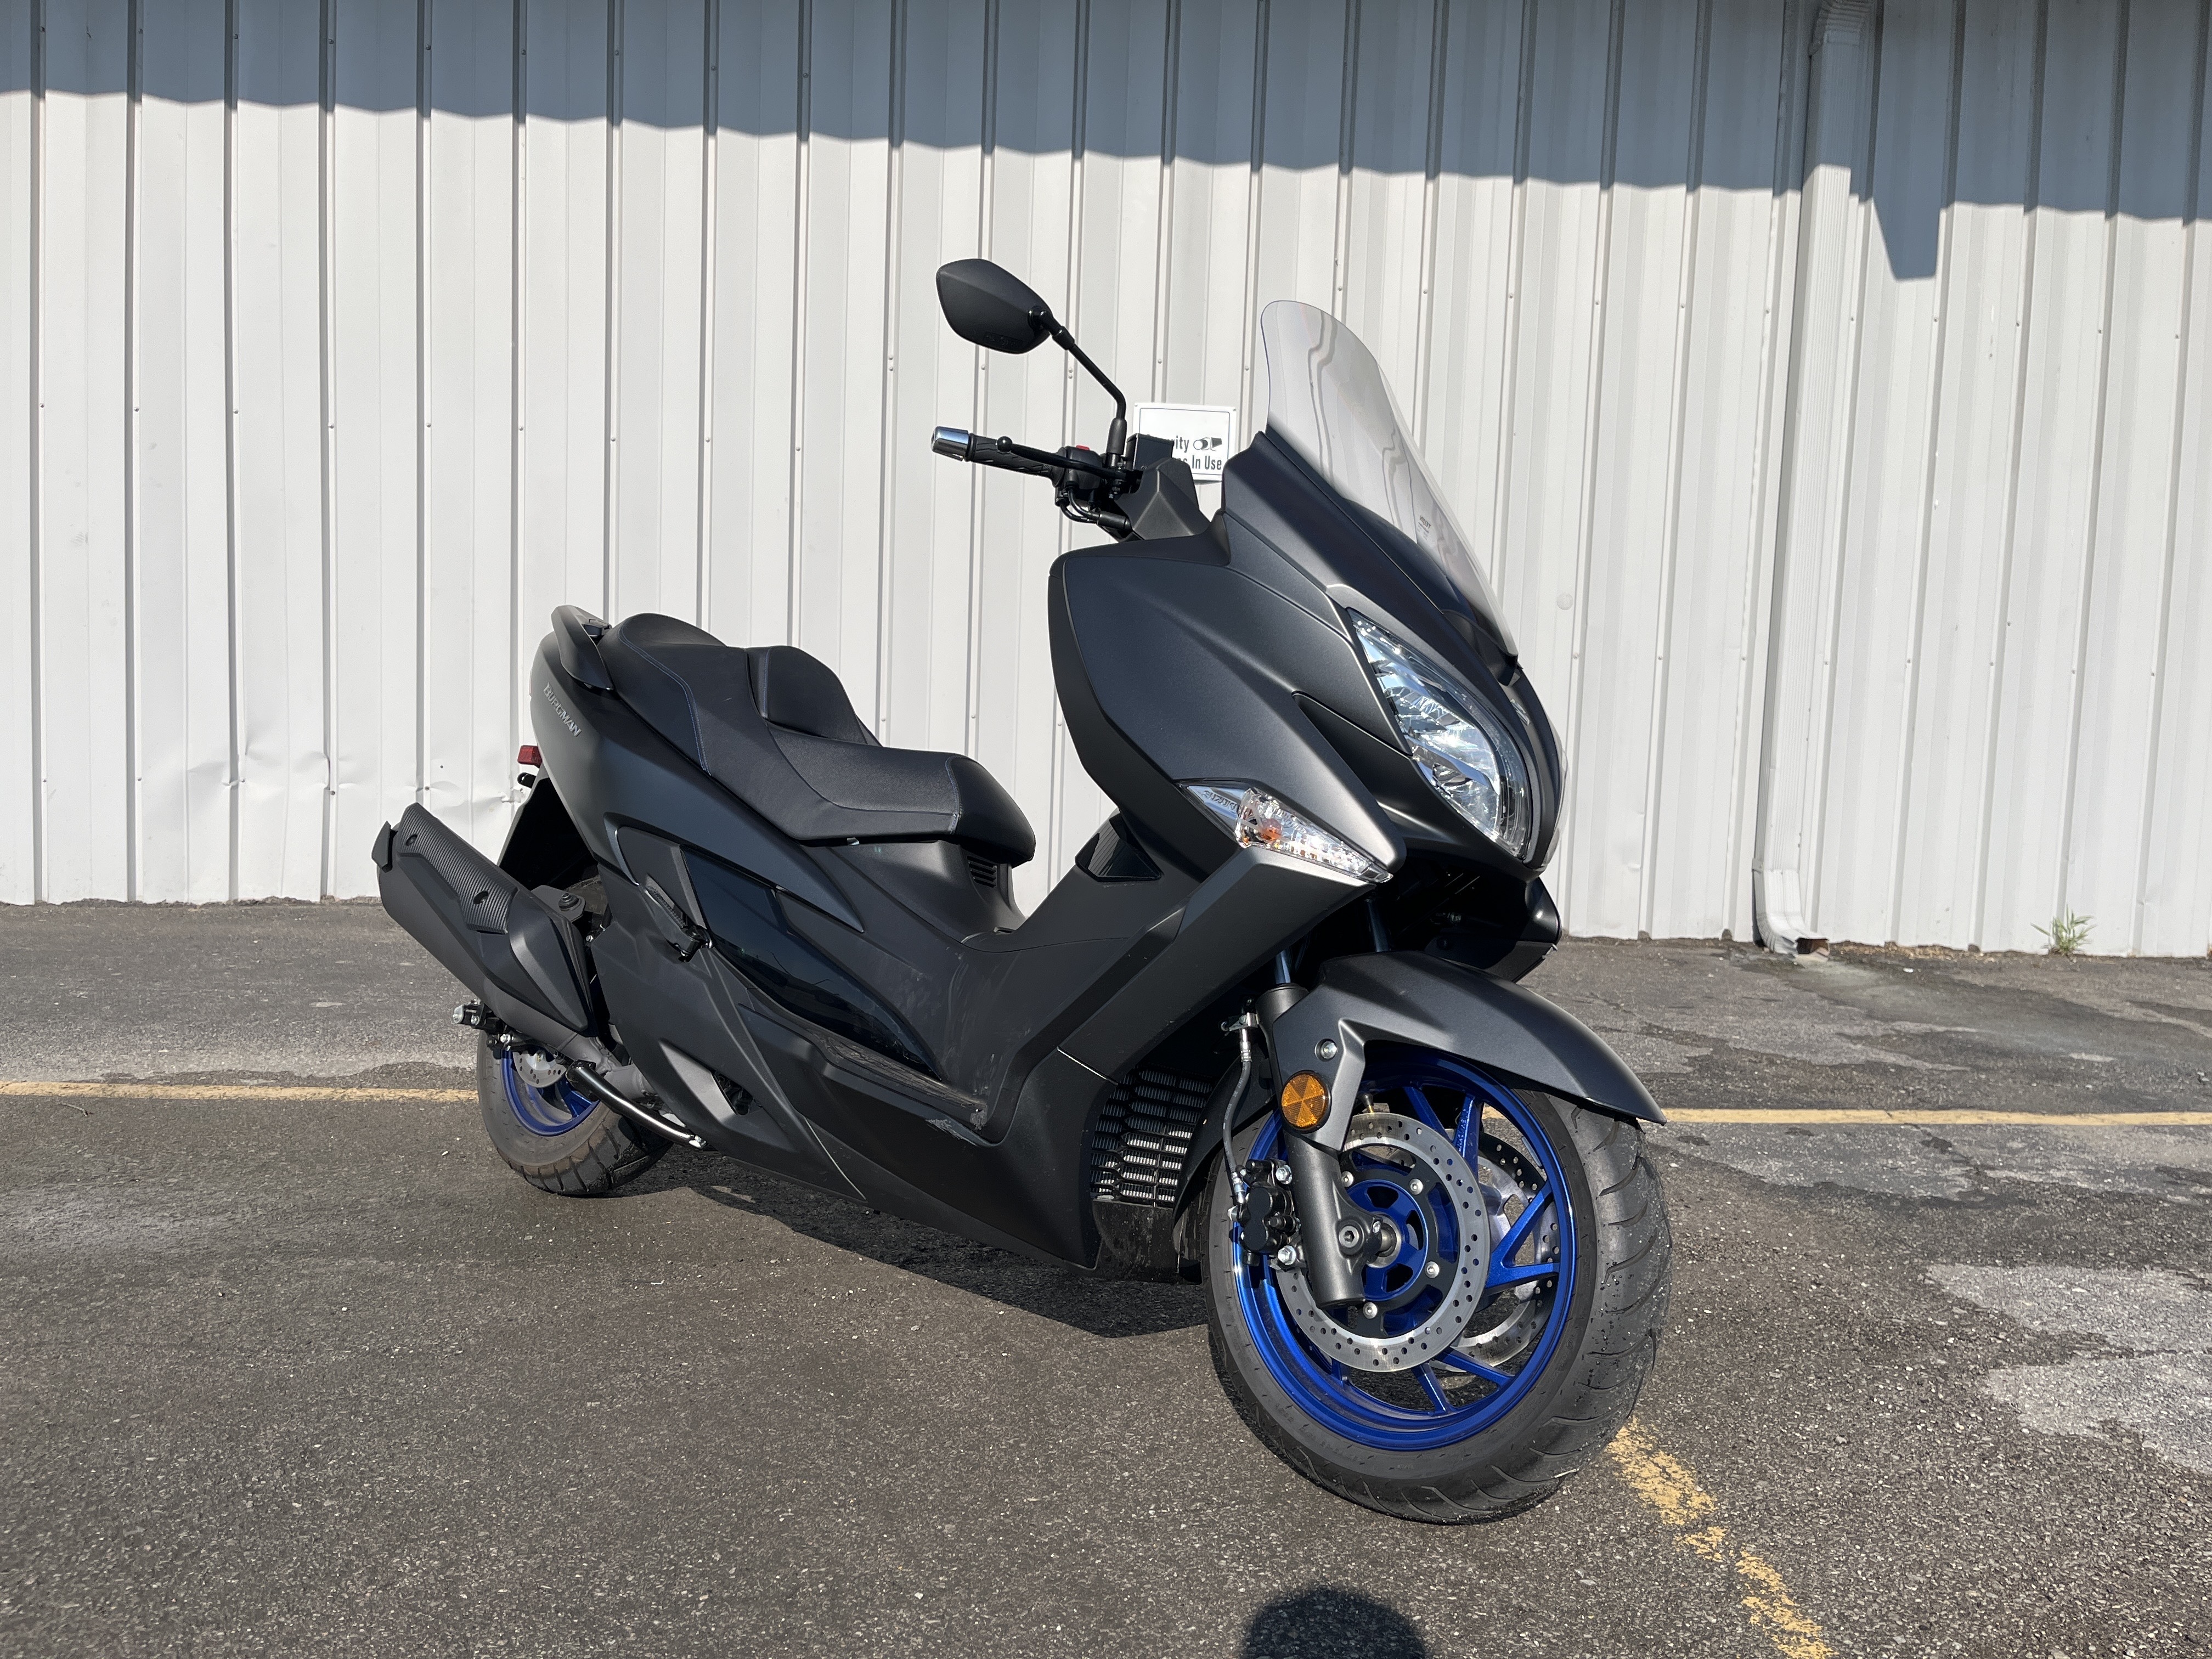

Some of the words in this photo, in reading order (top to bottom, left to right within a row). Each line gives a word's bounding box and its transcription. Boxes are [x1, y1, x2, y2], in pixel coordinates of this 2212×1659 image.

[1192, 455, 1201, 470] In
[1204, 455, 1222, 470] Use
[543, 682, 582, 737] BURGMAN
